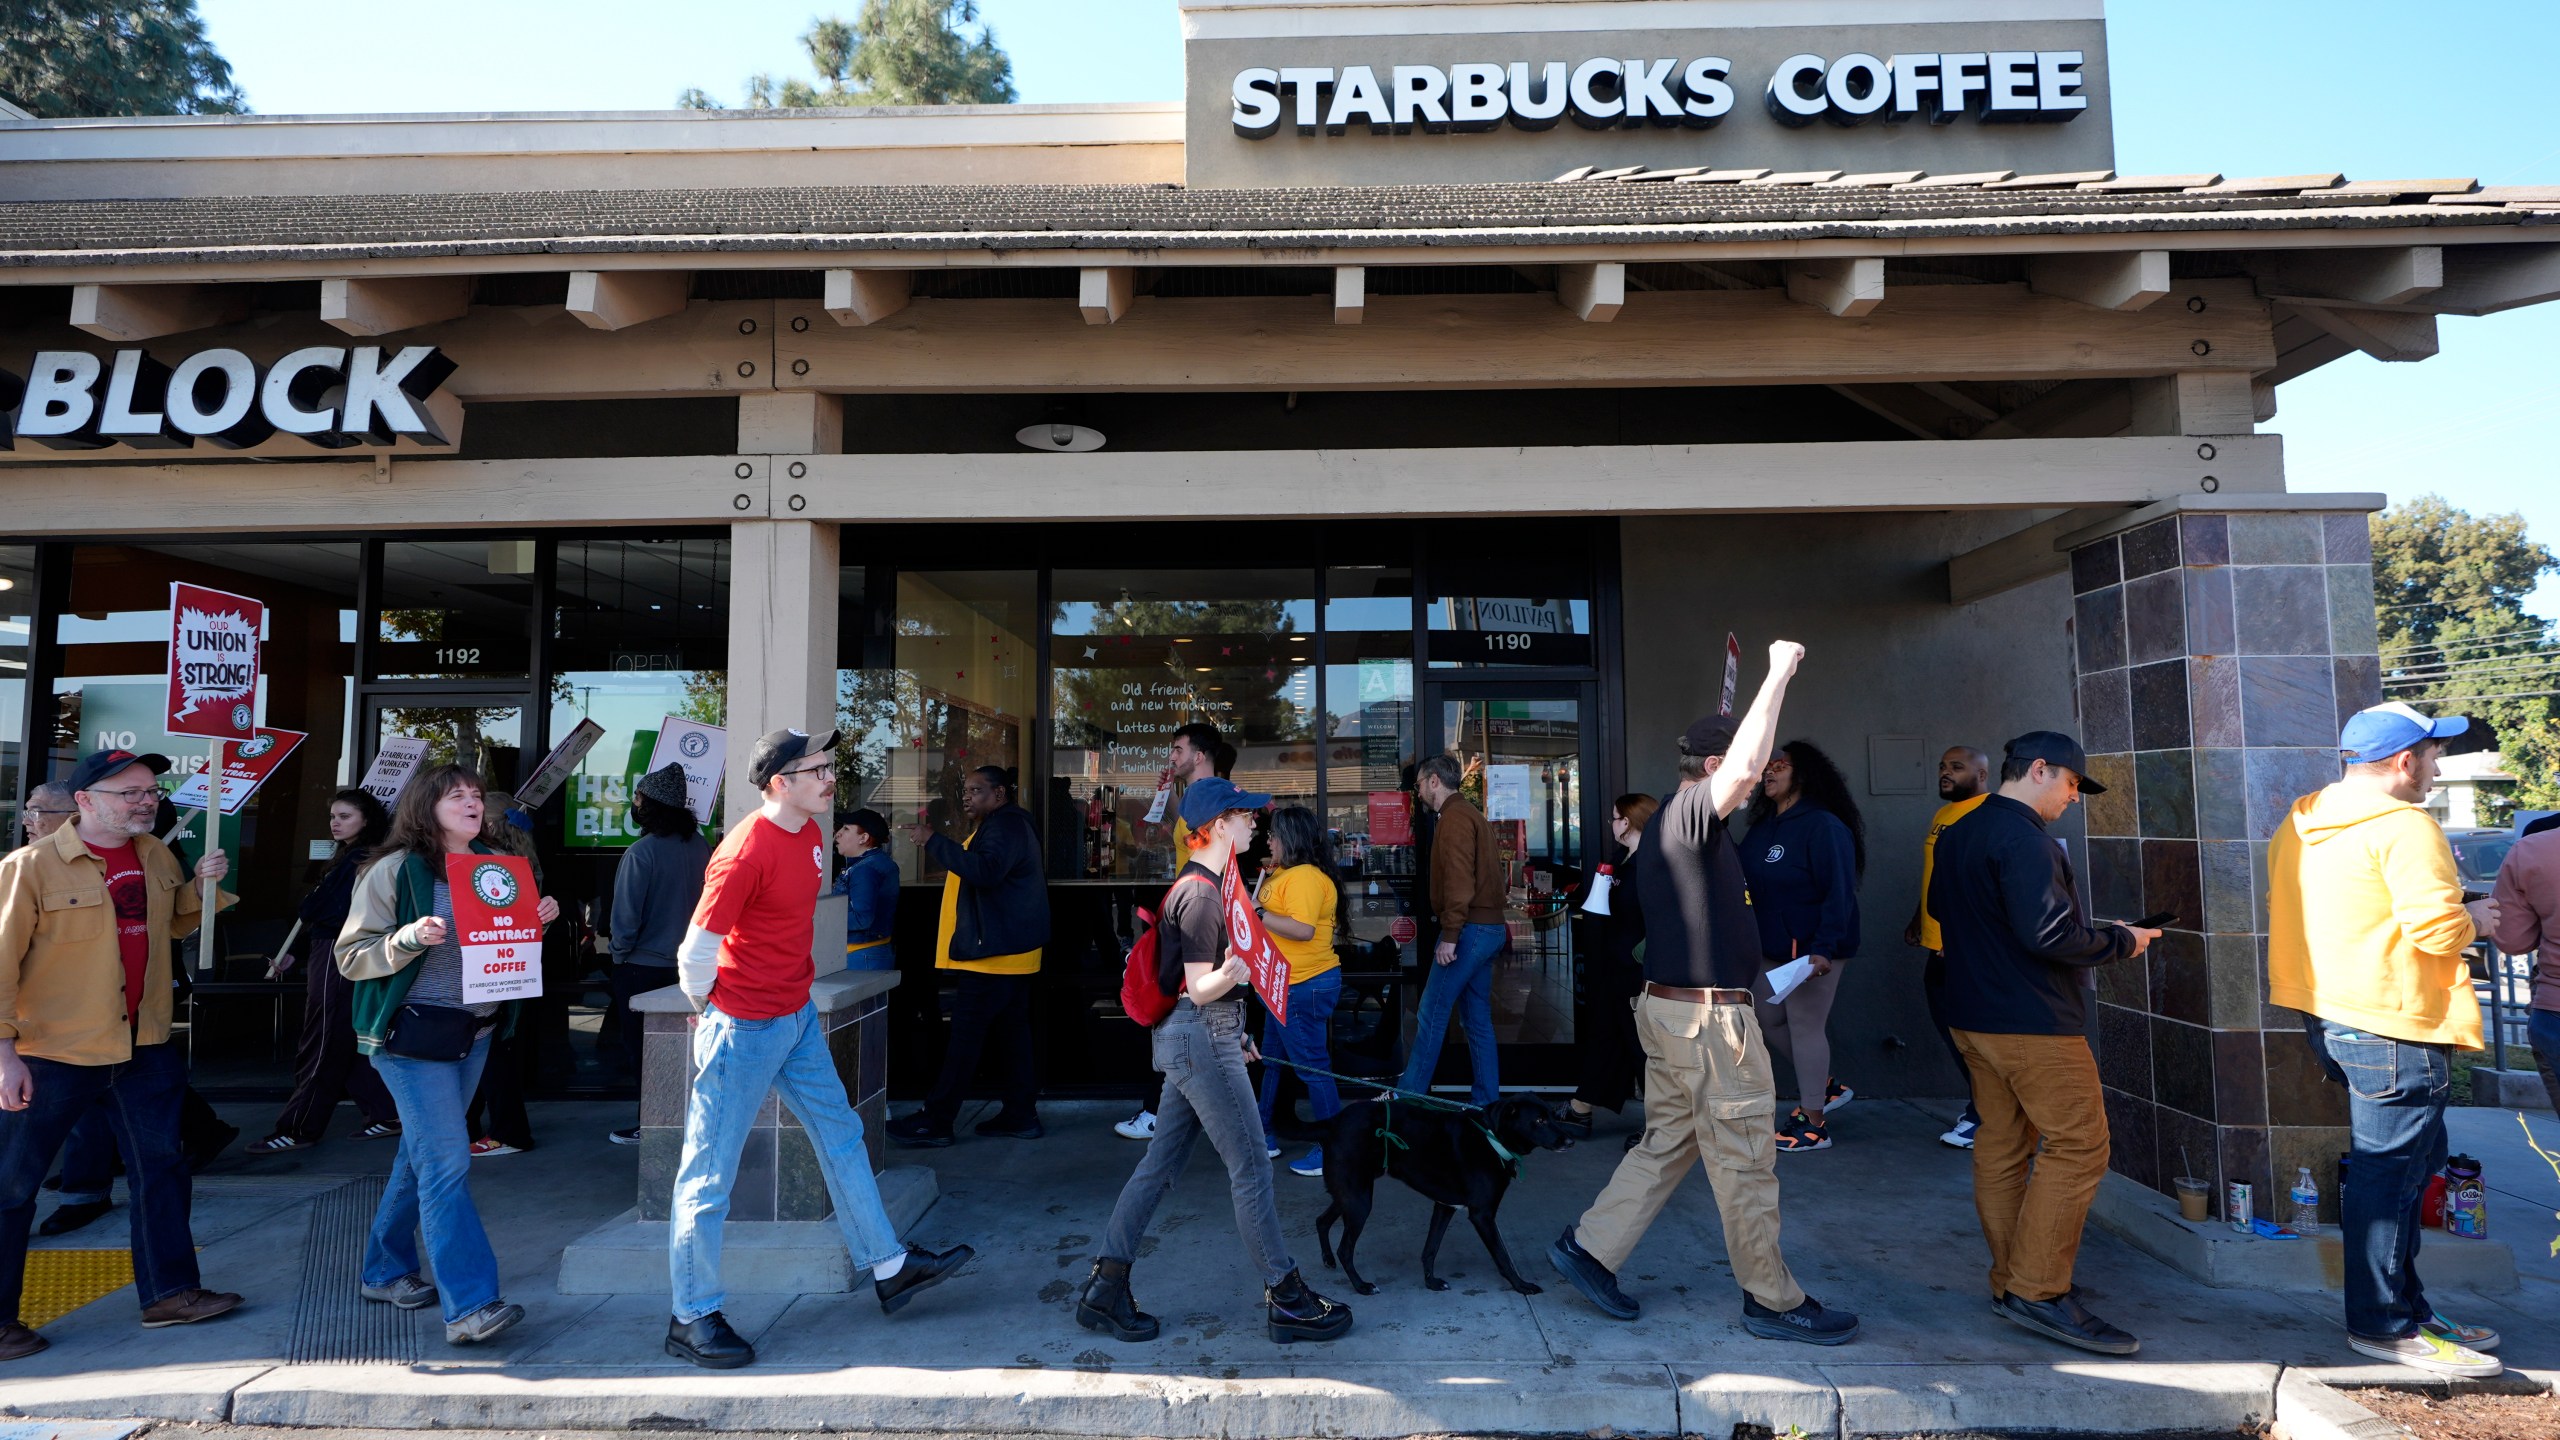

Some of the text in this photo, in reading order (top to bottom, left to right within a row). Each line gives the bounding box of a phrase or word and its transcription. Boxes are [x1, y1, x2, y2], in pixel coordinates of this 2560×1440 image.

[1231, 50, 2088, 133] STARBUCKS COFFEE
[15, 346, 438, 436] BLOCK
[209, 620, 229, 630] OUR
[187, 630, 246, 652] UNION
[1484, 633, 1532, 650] 1190
[217, 653, 225, 662] IS
[436, 648, 480, 664] 1192
[184, 663, 251, 686] STRONG!
[1365, 669, 1387, 692] A
[1122, 682, 1194, 696] Old friends
[1111, 699, 1233, 711] and new traditions.
[1116, 721, 1156, 733] Lattes
[98, 731, 136, 750] NO
[380, 750, 418, 760] STARBUCKS
[1107, 741, 1148, 759] Starry
[229, 761, 245, 769] NO
[379, 759, 410, 768] WORKERS
[378, 768, 401, 776] UNITED
[376, 787, 396, 797] ULP
[474, 864, 510, 878] STARBUCKS
[474, 880, 501, 906] WORKERS
[493, 916, 513, 927] NO
[468, 929, 537, 942] CONTRACT
[497, 948, 515, 959] NO
[483, 961, 527, 974] COFFEE
